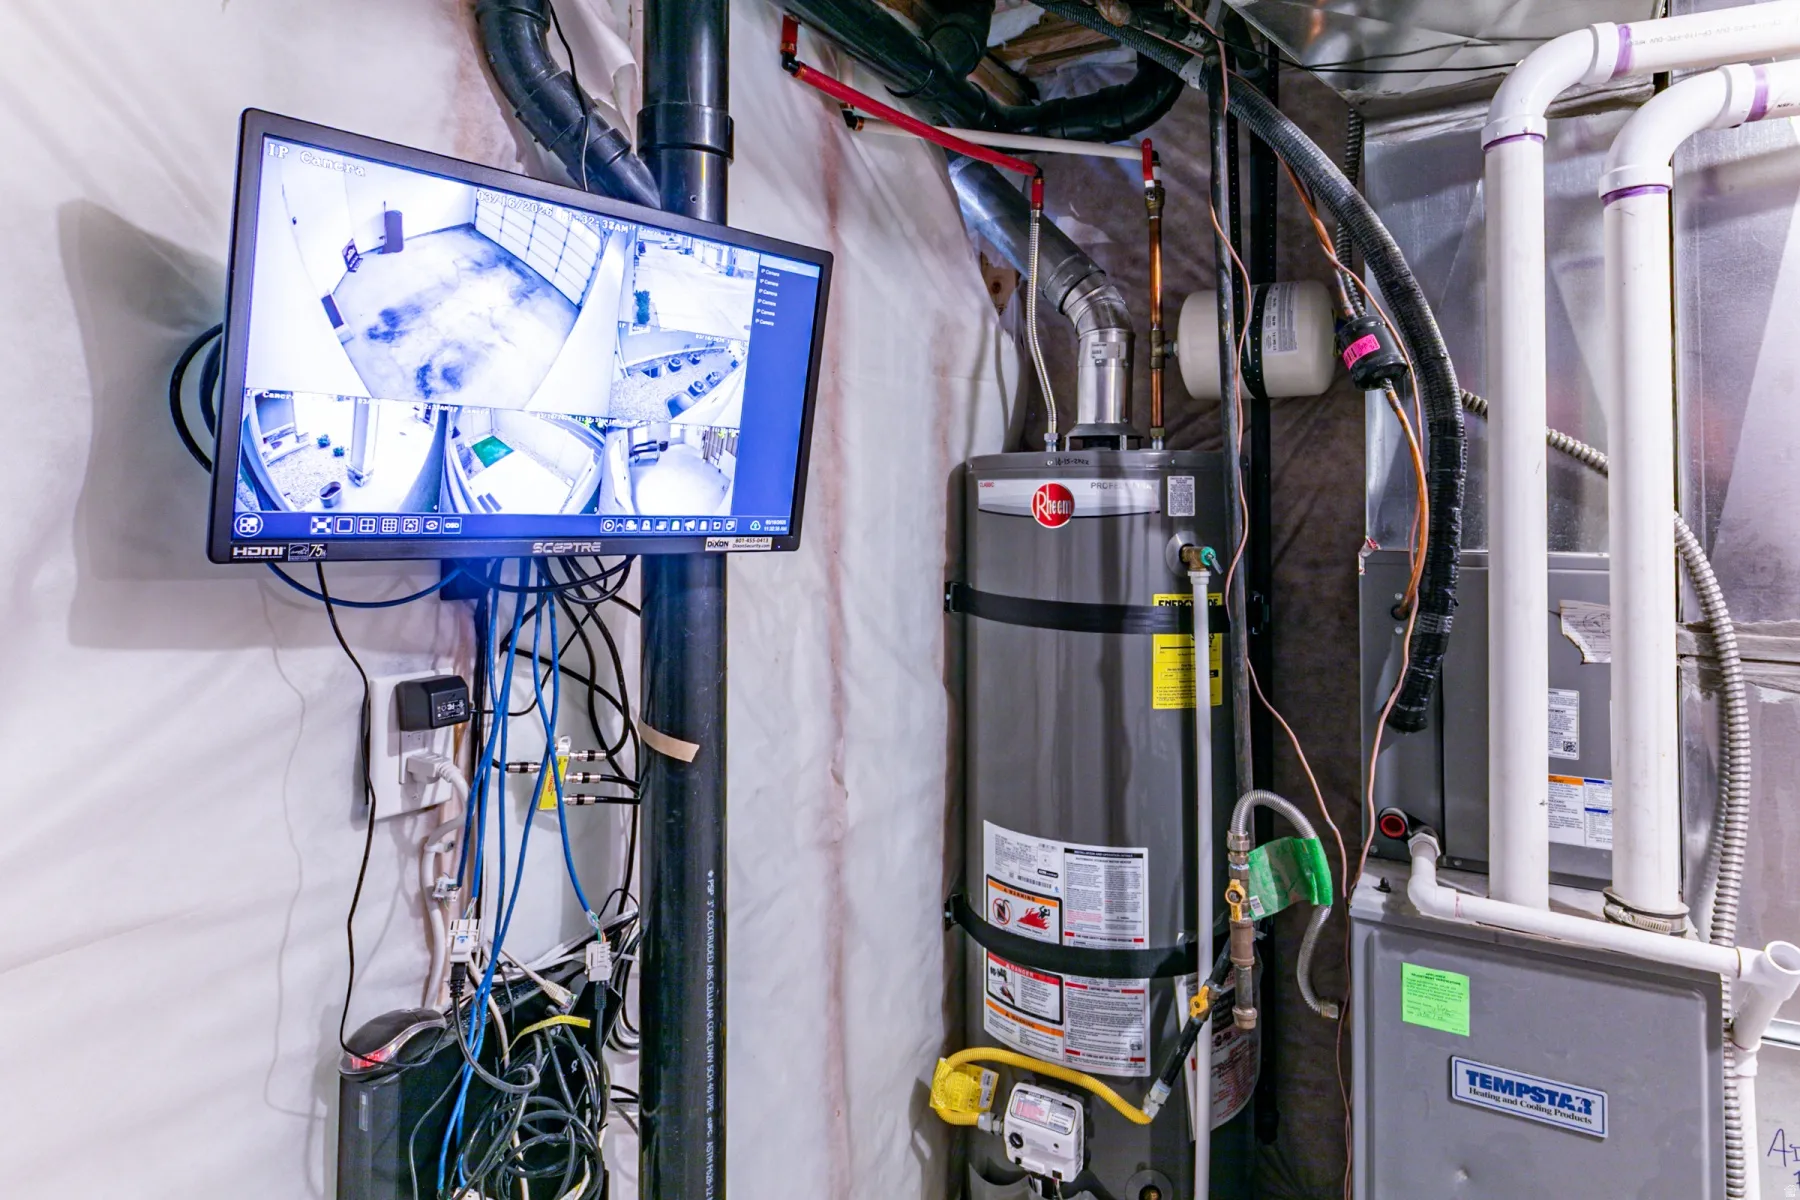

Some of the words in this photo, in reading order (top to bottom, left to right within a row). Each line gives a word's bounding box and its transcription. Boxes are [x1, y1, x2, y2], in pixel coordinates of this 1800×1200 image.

[268, 143, 289, 159] IP
[300, 151, 366, 177] Camera
[477, 190, 553, 217] 03/16/2026
[1036, 484, 1071, 520] Rheem
[233, 546, 286, 556] HDMI
[532, 542, 601, 554] SCEPTRE
[1009, 889, 1035, 902] WARNING
[1010, 965, 1034, 978] DANGER
[1011, 1015, 1036, 1028] WARNING
[707, 1082, 714, 1093] 40
[1466, 1070, 1592, 1115] TEMPSTAR
[1469, 1087, 1500, 1102] Heating
[1502, 1097, 1518, 1106] and
[1520, 1101, 1552, 1116] Cooling
[1554, 1109, 1592, 1124] Products
